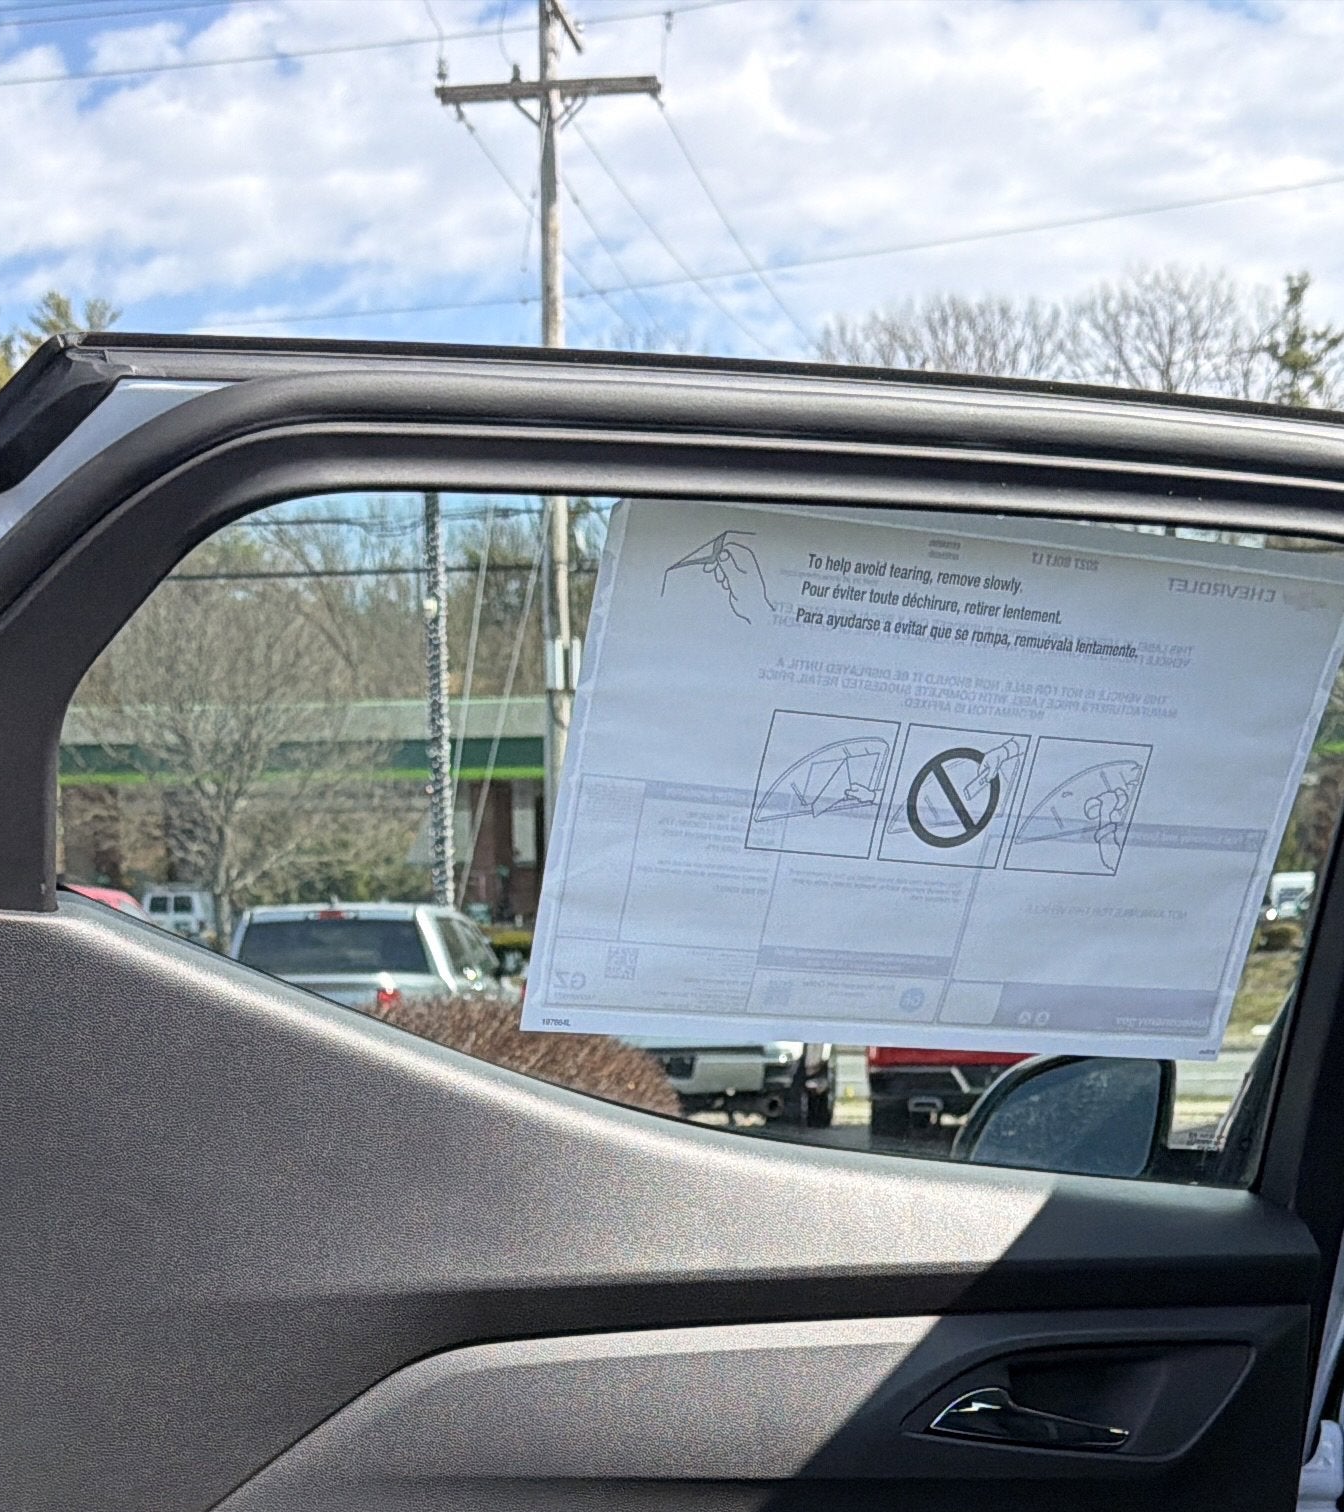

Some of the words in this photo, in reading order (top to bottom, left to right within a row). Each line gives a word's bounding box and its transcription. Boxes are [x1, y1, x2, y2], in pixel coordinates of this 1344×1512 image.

[809, 553, 823, 570] To
[825, 555, 852, 576] help
[854, 560, 888, 577] avoid
[889, 563, 933, 585] tearing,
[936, 570, 981, 588] remove
[983, 574, 1023, 596] slowly.
[801, 580, 831, 598] Pour
[832, 583, 868, 602] éviter
[869, 588, 900, 606] toute
[902, 592, 961, 615] déchirure,
[964, 600, 1002, 617] retirer
[1002, 604, 1063, 625] lentement.
[795, 607, 824, 625] Para
[826, 613, 881, 631] ayudarse
[883, 620, 891, 633] a
[894, 620, 928, 637] evitar
[930, 624, 953, 641] que
[954, 628, 969, 641] se
[971, 630, 1011, 649] rompa,
[1014, 633, 1074, 653] remuévala
[1075, 639, 1139, 659] lentamente.
